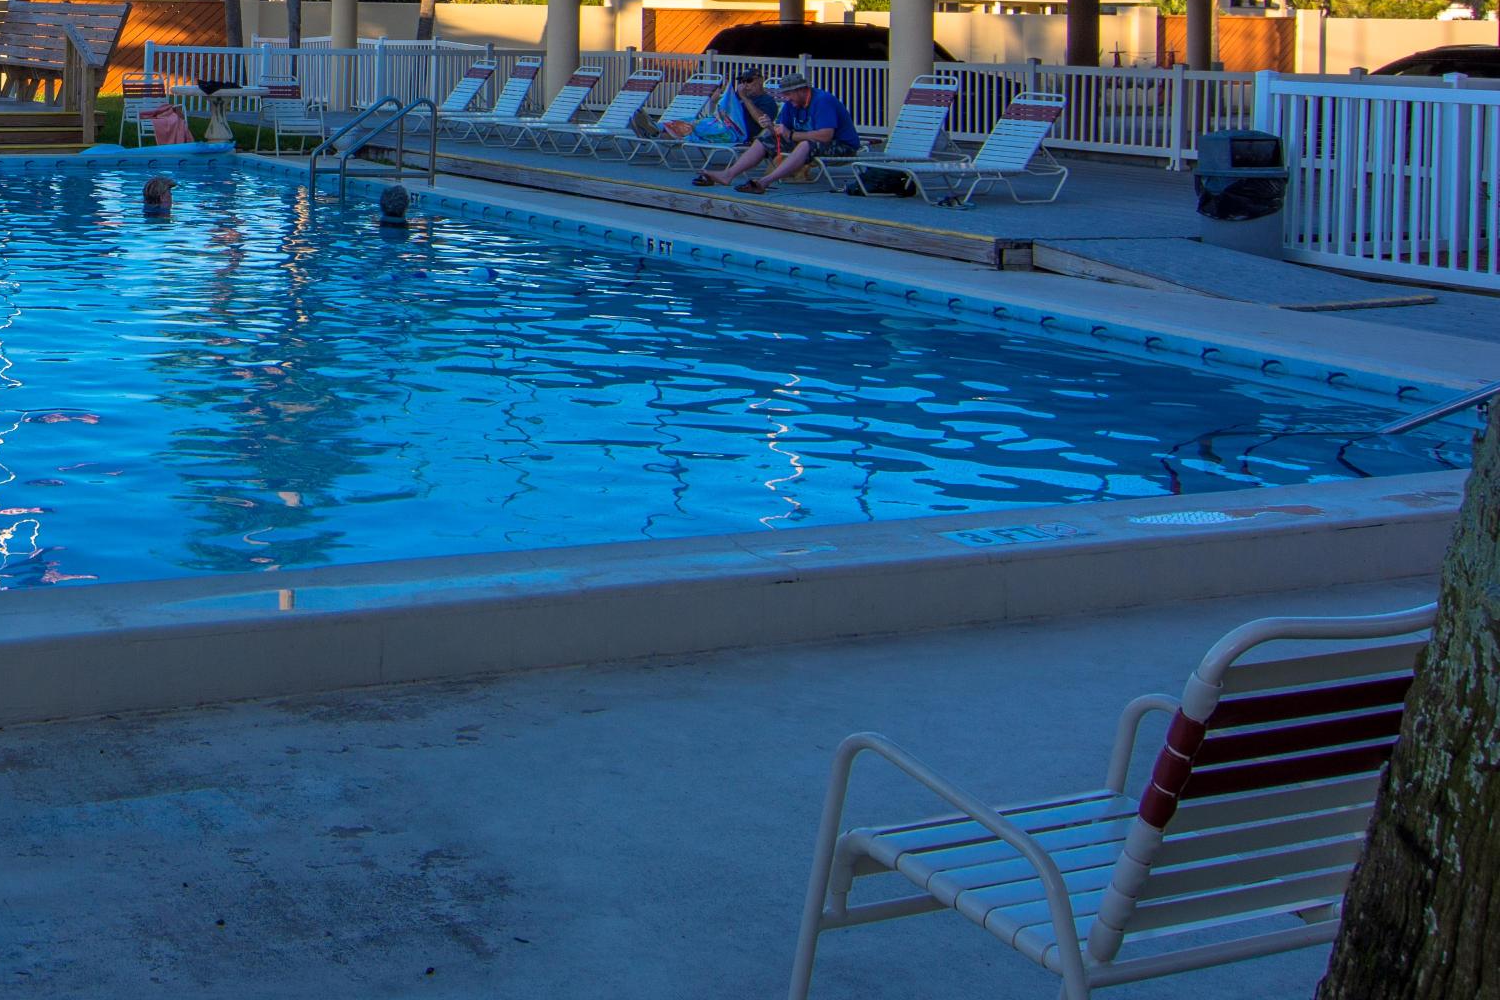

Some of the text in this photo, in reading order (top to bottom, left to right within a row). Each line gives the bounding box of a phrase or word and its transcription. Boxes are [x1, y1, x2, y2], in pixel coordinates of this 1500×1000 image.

[659, 239, 672, 256] FT
[956, 531, 993, 544] 3
[992, 525, 1046, 541] FT
